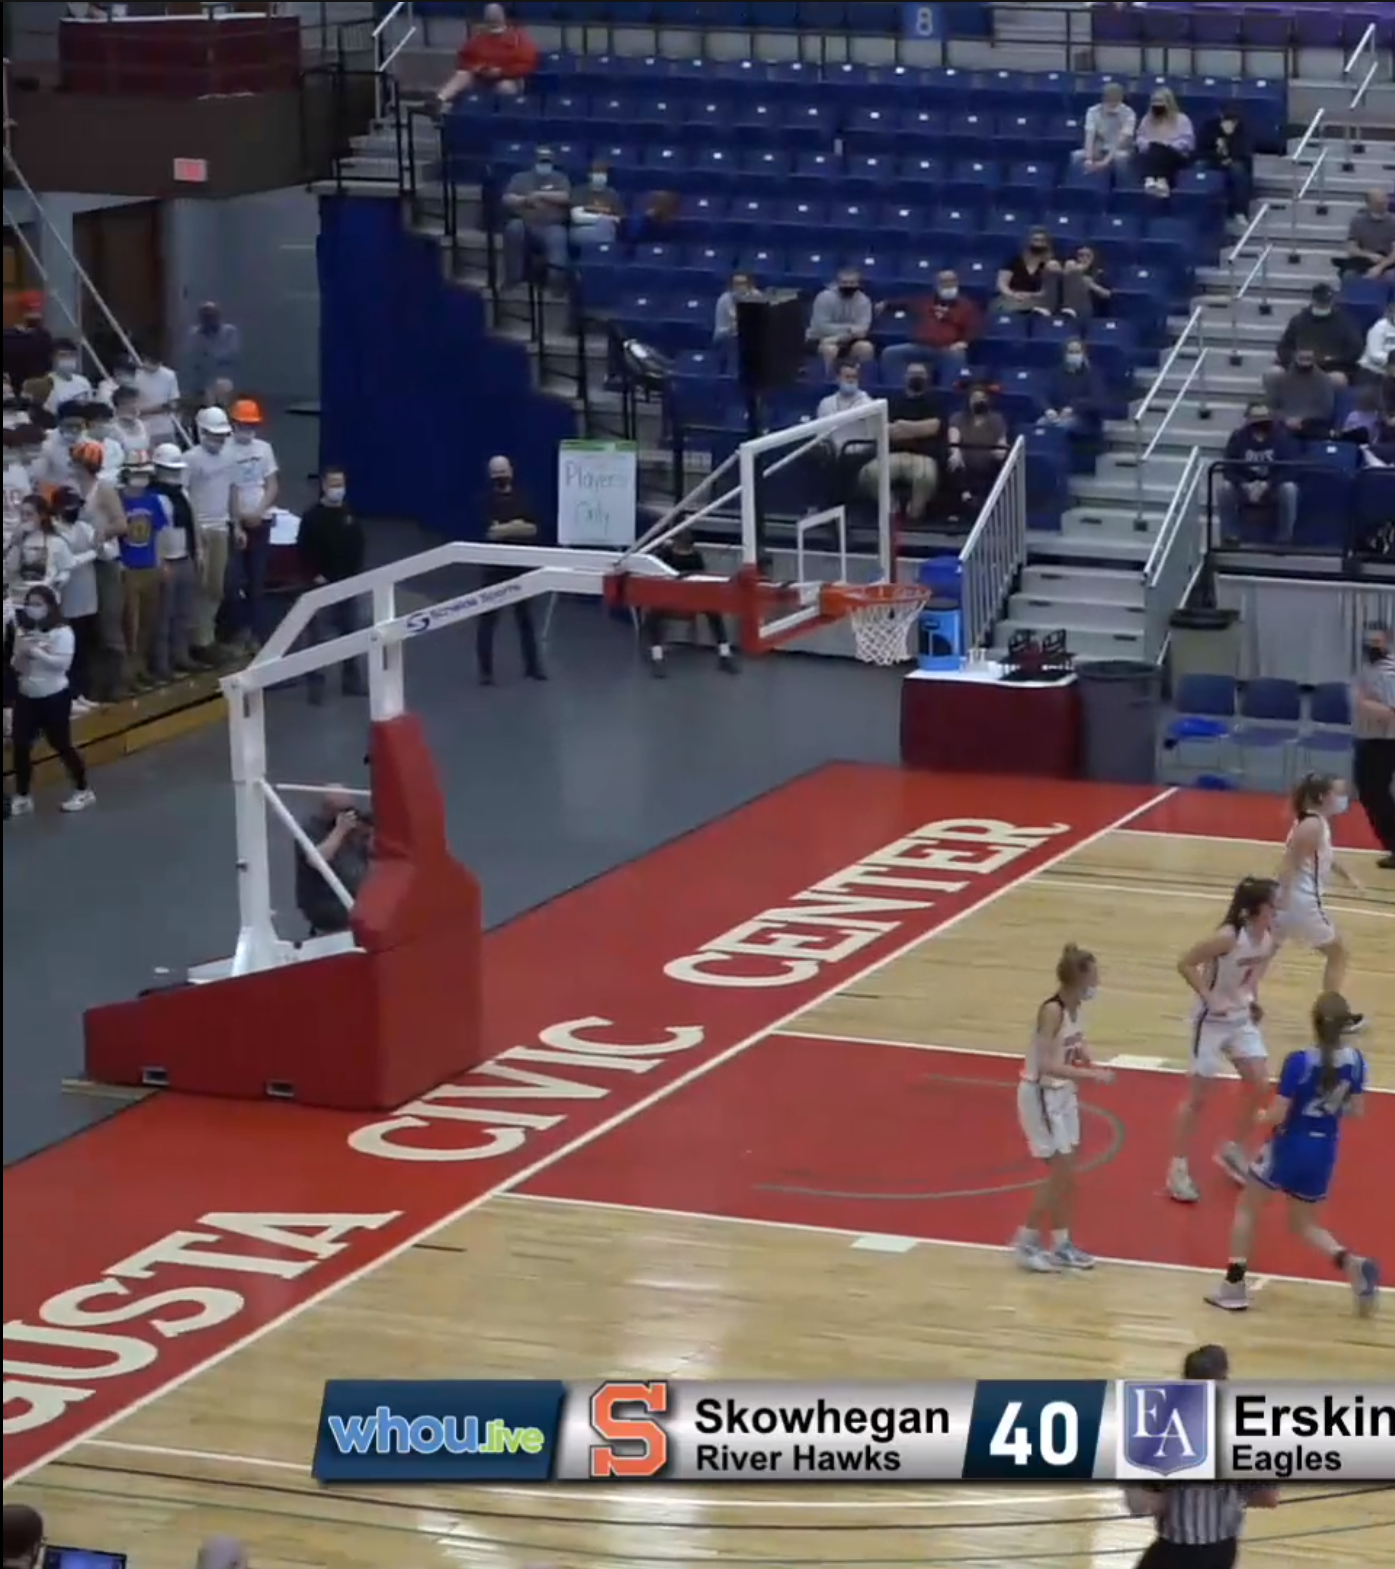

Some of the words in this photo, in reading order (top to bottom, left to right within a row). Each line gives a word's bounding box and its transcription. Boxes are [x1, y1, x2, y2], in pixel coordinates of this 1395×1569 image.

[916, 7, 934, 37] 8
[348, 1016, 704, 1162] CIVIC
[663, 818, 1071, 987] CENTER
